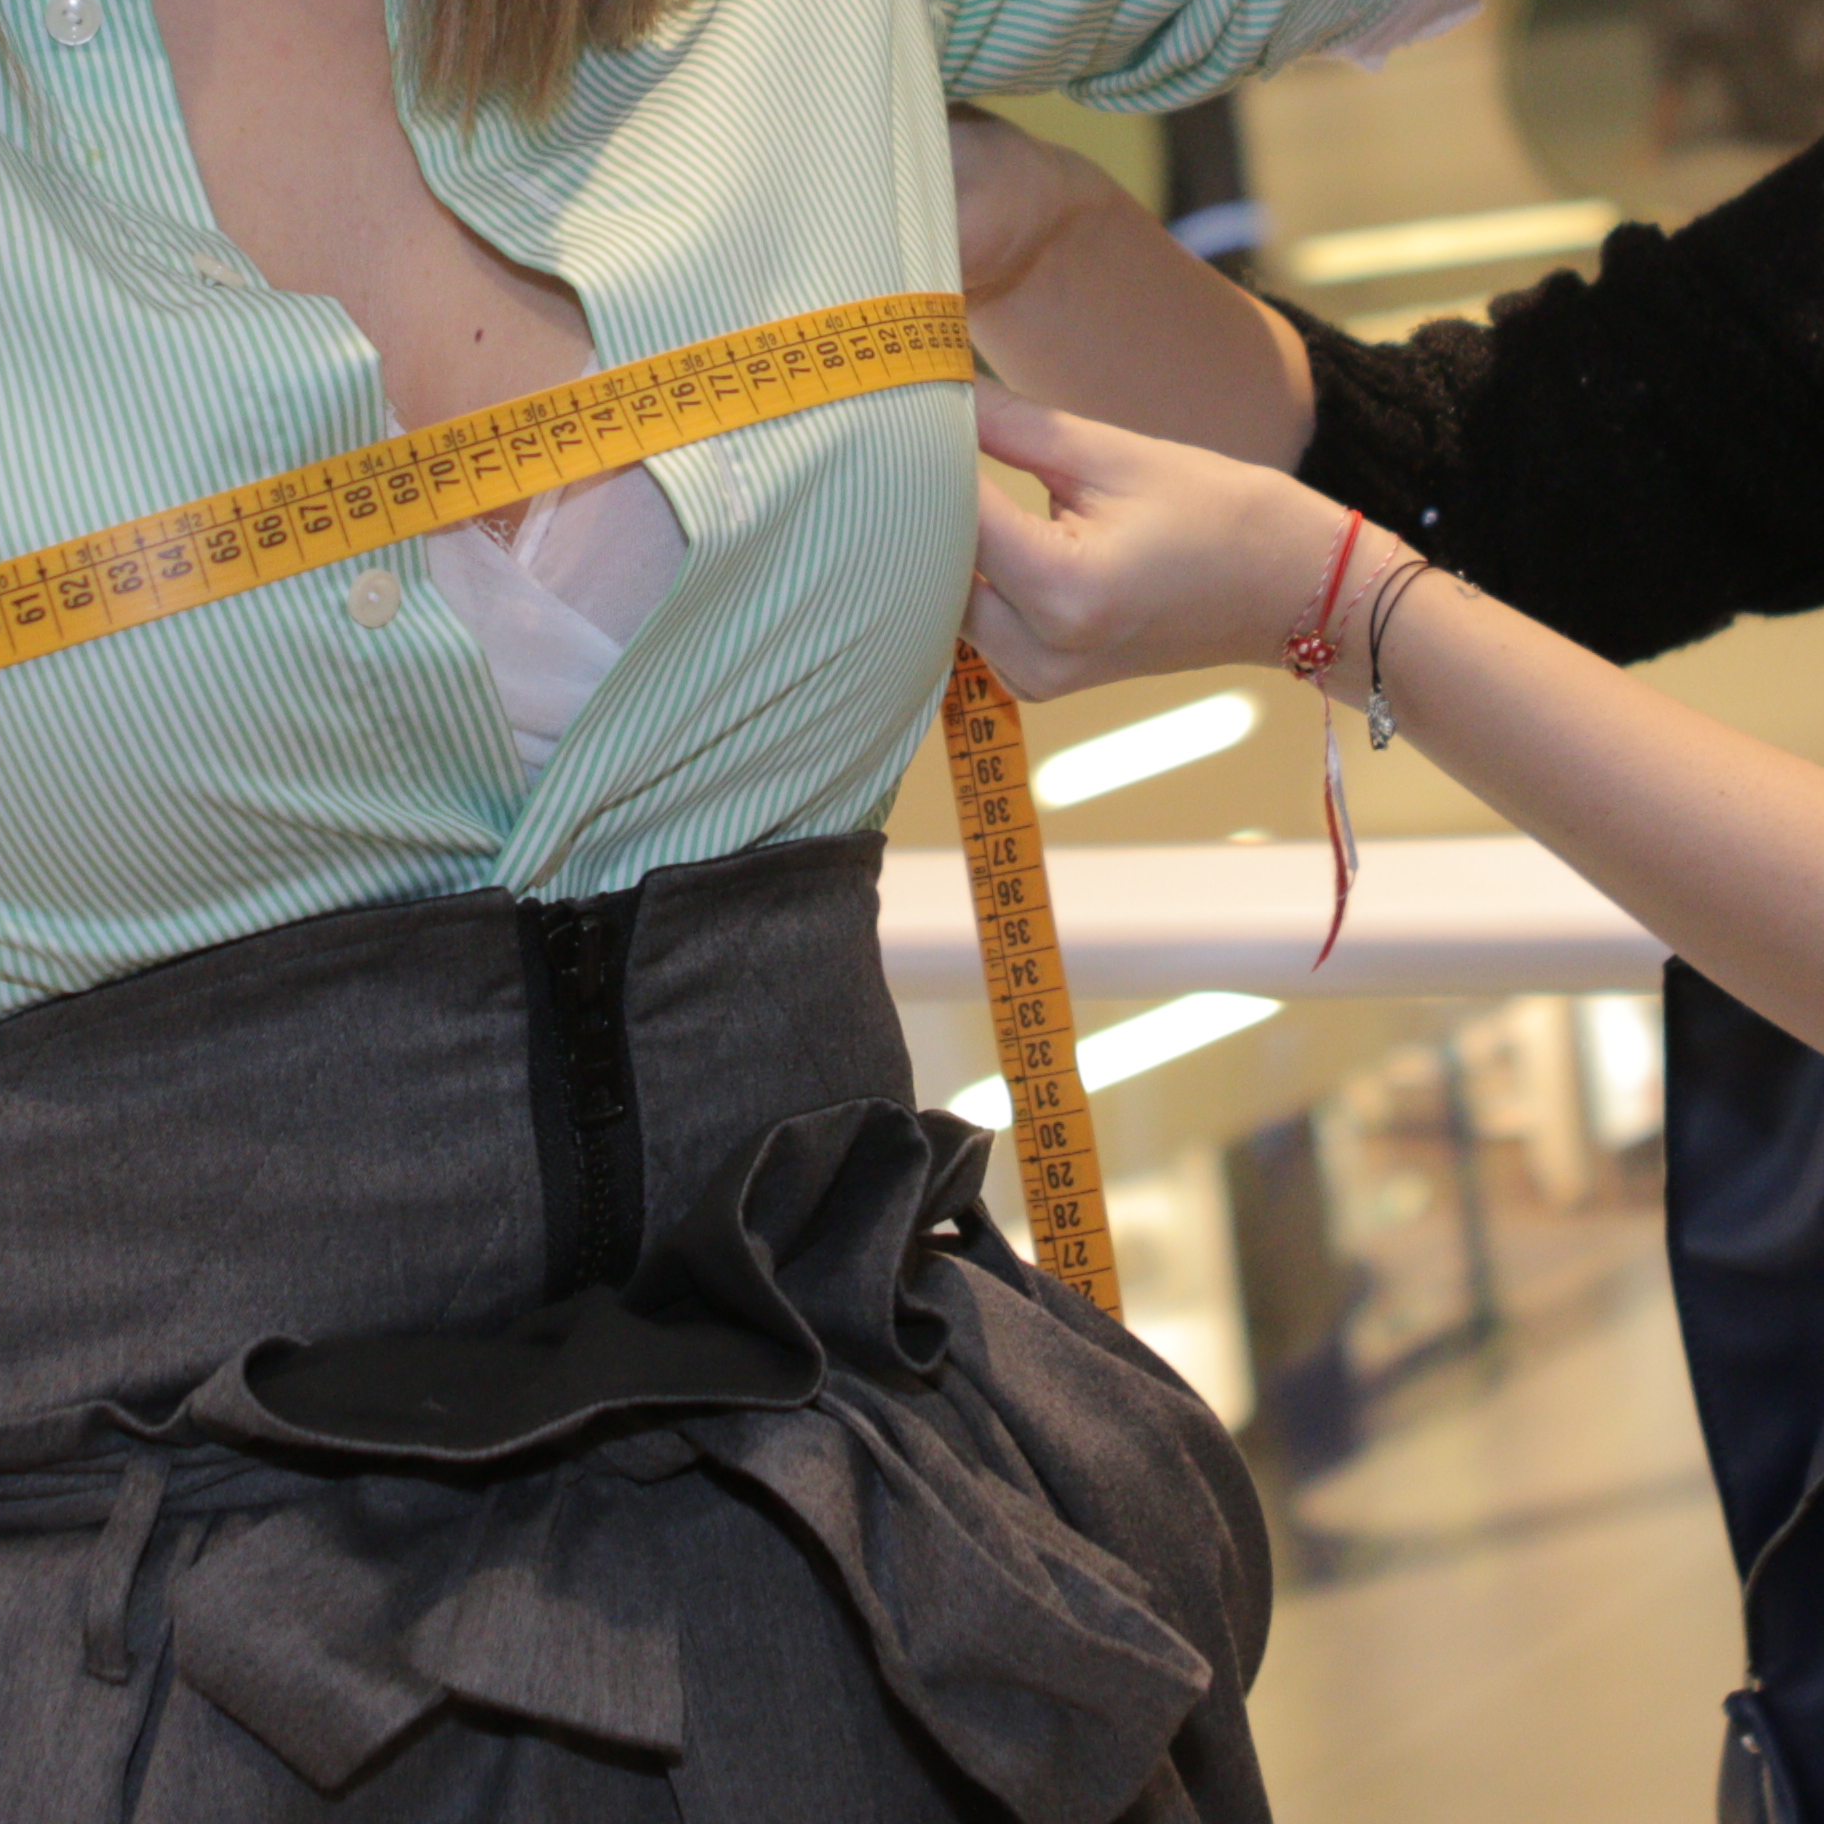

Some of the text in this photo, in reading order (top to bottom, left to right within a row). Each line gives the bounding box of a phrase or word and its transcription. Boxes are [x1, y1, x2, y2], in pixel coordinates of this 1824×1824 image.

[850, 336, 875, 360] 81
[879, 328, 902, 354] 82
[904, 324, 923, 350] 83
[783, 350, 811, 379] 79
[817, 341, 845, 369] 80
[709, 375, 739, 401] 77
[747, 360, 776, 389] 78
[631, 395, 663, 426] 75
[671, 382, 701, 413] 76
[551, 421, 582, 453] 73
[592, 407, 623, 439] 74
[471, 449, 502, 479] 71
[511, 433, 542, 466] 72
[388, 473, 420, 504] 69
[429, 460, 460, 493] 70
[345, 486, 377, 519] 68
[253, 515, 287, 548] 66
[299, 505, 333, 533] 67
[207, 530, 241, 563] 65
[158, 545, 193, 580] 64
[108, 560, 143, 595] 63
[59, 576, 94, 610] 62
[11, 594, 46, 625] 61
[965, 676, 988, 703] 41
[969, 716, 995, 744] 40
[978, 756, 1004, 785] 39
[983, 797, 1011, 825] 38
[993, 837, 1018, 867] 37
[997, 878, 1024, 906] 36
[1004, 918, 1031, 946] 35
[1011, 960, 1039, 987] 34
[1019, 999, 1046, 1028] 33
[1026, 1040, 1053, 1069] 32
[1034, 1081, 1060, 1109] 31
[1039, 1122, 1067, 1150] 30
[1047, 1161, 1075, 1189] 29
[1055, 1201, 1080, 1229] 28
[1062, 1241, 1088, 1269] 27
